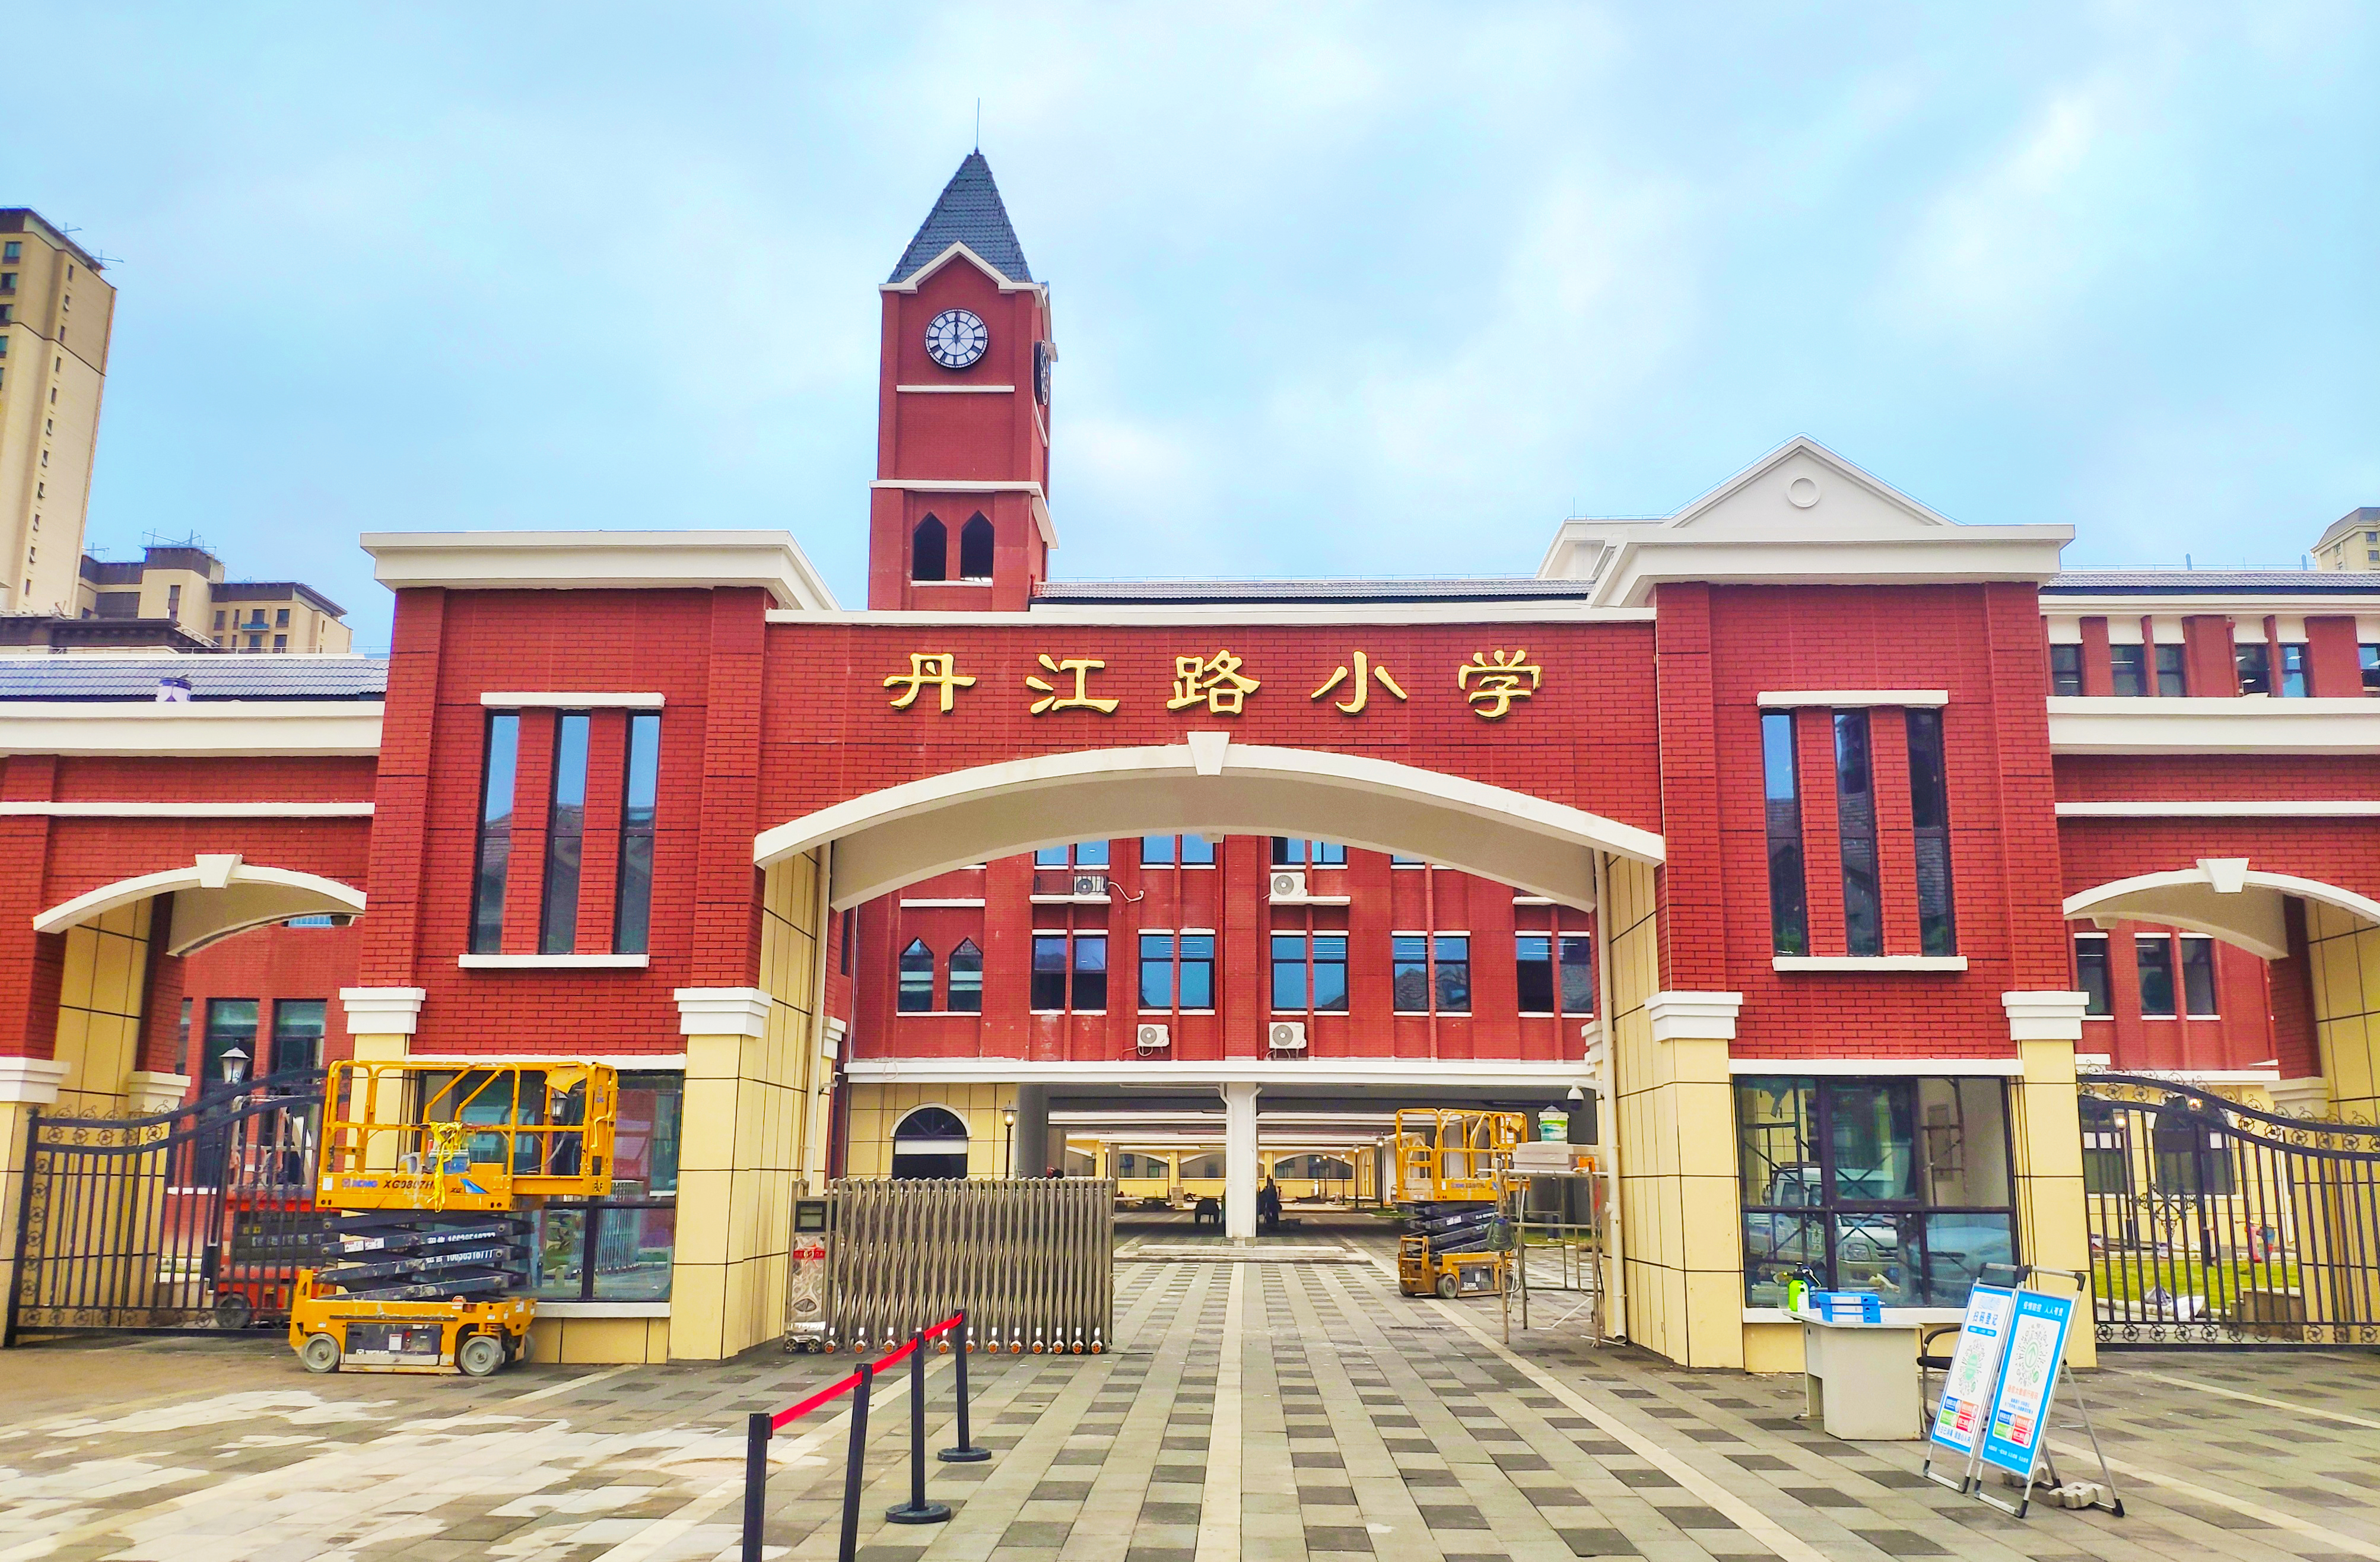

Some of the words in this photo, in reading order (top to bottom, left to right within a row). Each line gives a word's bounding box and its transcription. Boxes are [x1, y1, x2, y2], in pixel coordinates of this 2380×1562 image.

[882, 649, 1543, 719] 丹江路小学
[1972, 1310, 1998, 1326] 扫码登记
